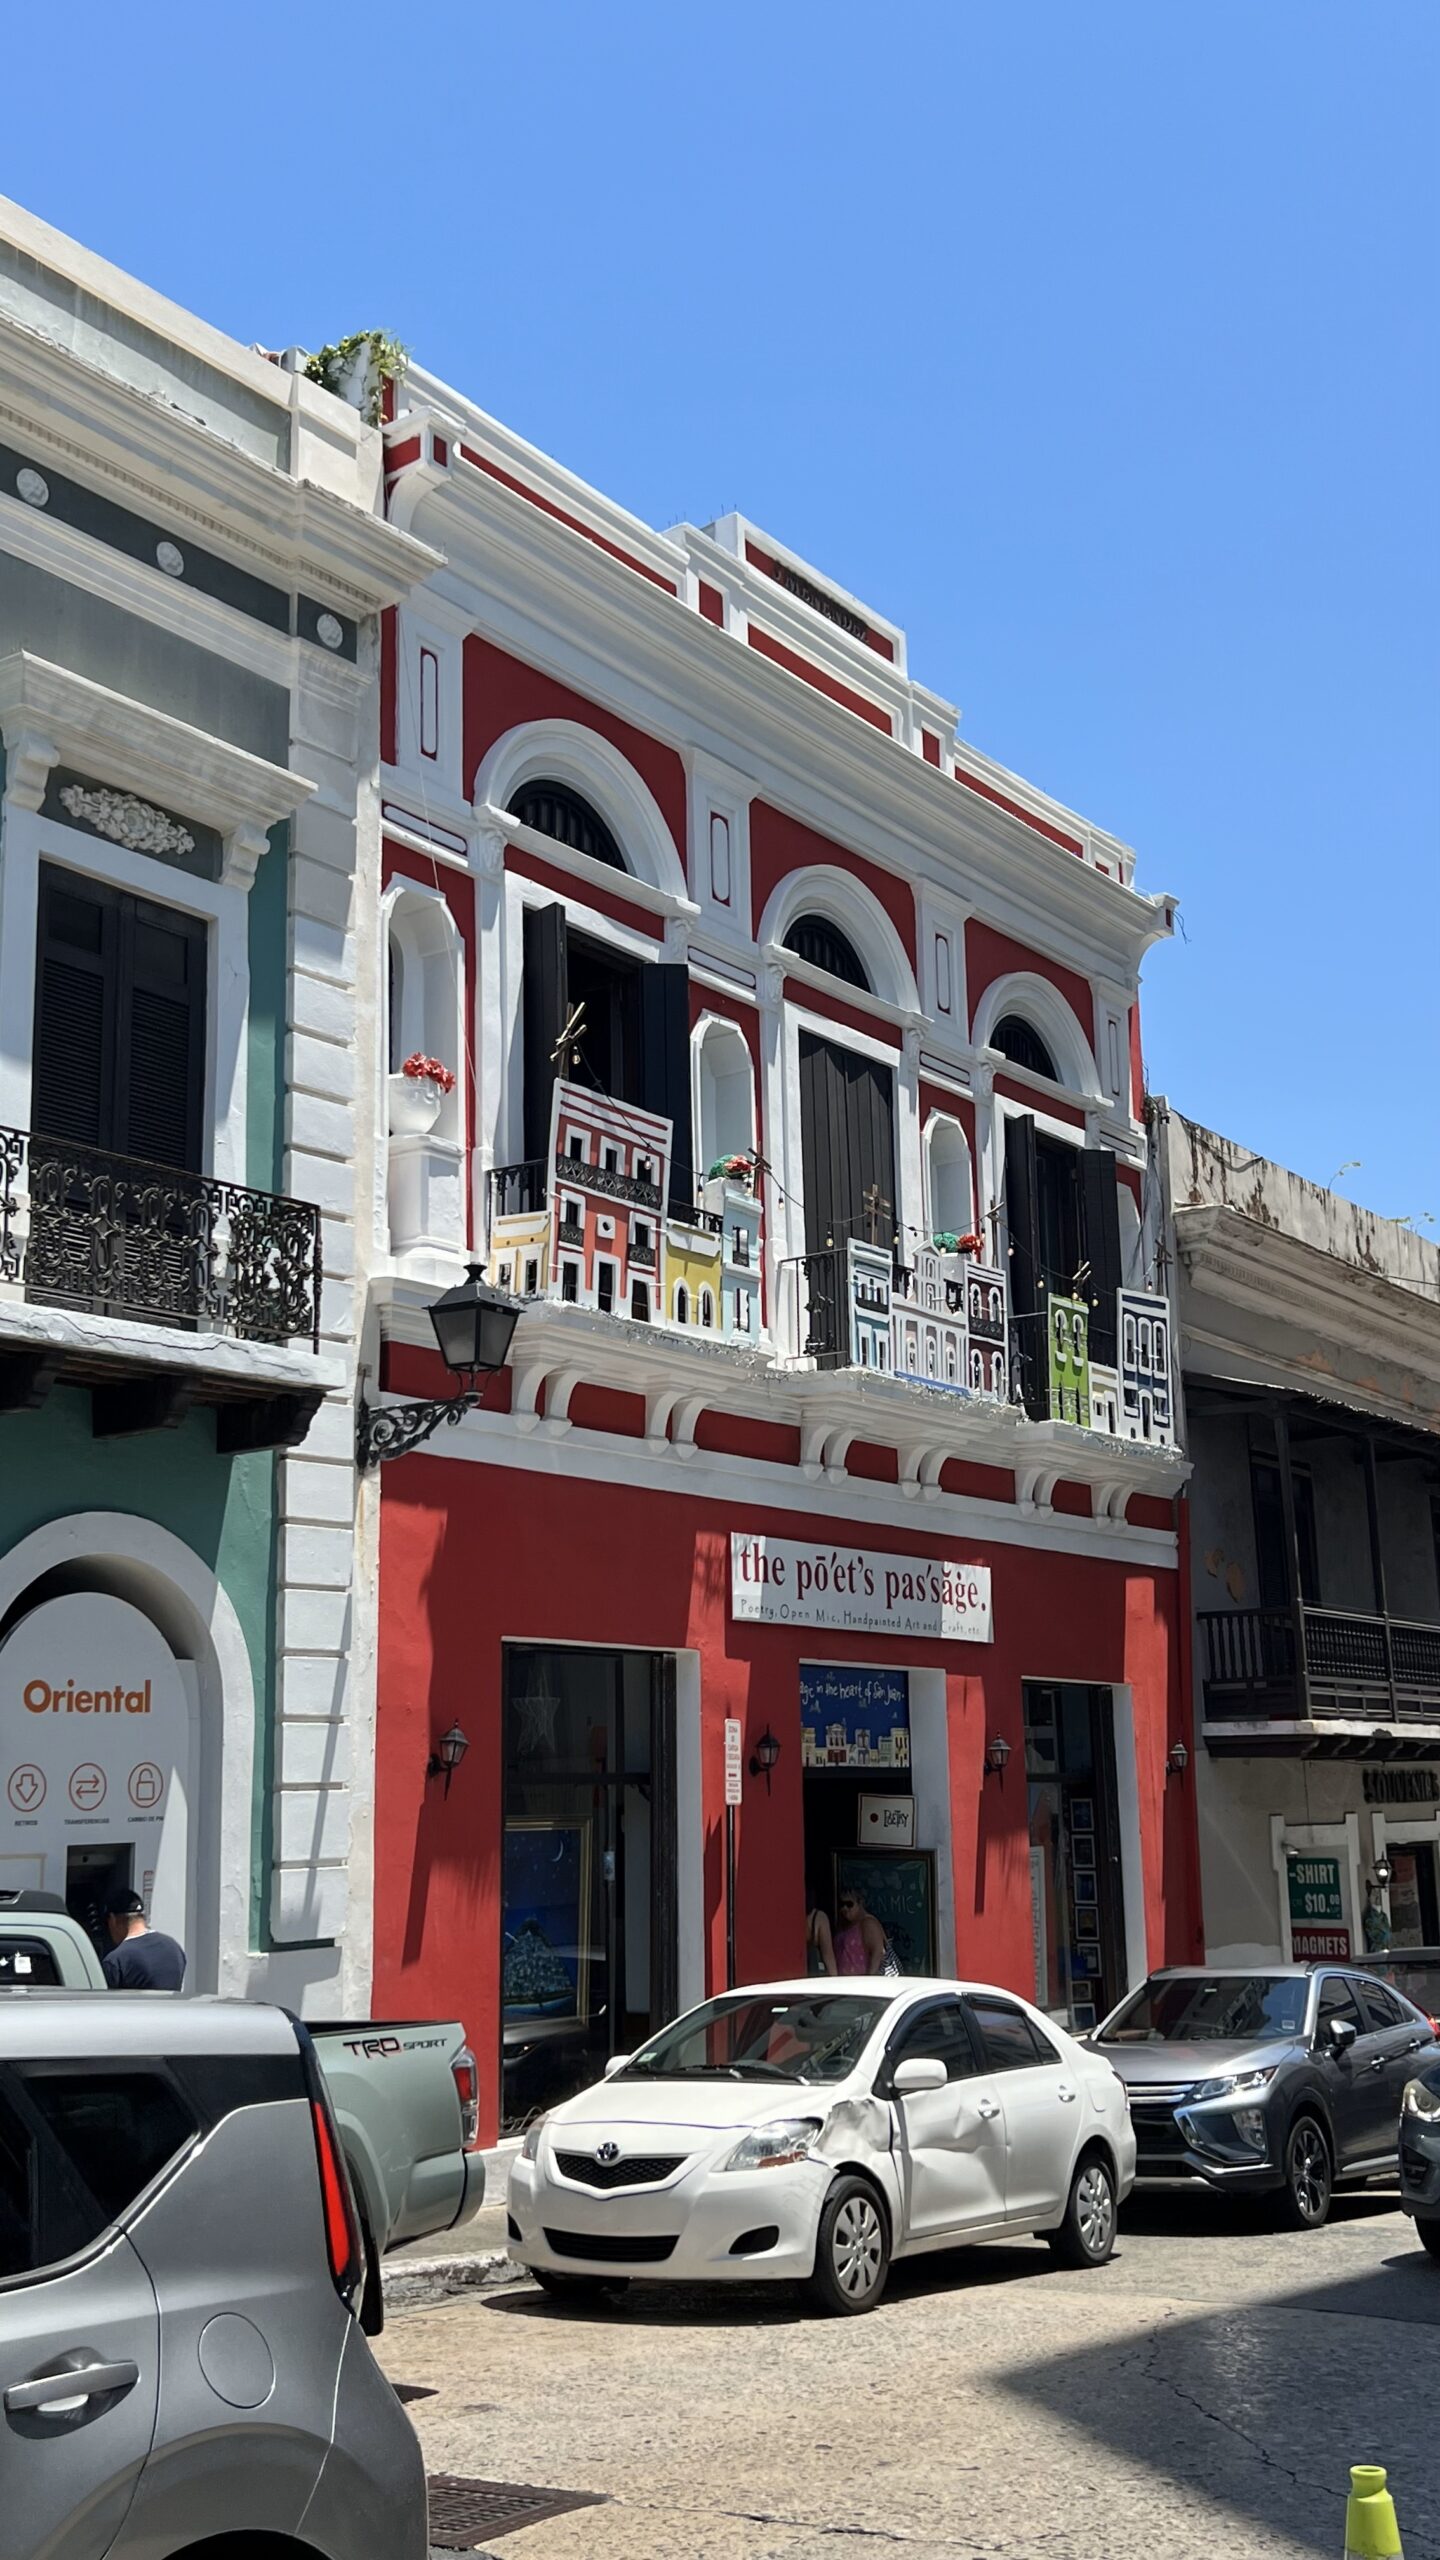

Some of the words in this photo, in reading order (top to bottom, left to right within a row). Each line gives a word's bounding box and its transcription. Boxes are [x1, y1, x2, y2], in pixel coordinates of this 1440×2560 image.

[740, 1543, 786, 1586] the
[741, 1599, 777, 1620] Poetry,
[780, 1604, 810, 1620] Open
[843, 1611, 901, 1630] Handpainted
[905, 1618, 921, 1631] Art
[923, 1621, 938, 1632] and
[23, 1679, 152, 1714] Oriental
[800, 1681, 815, 1705] agic
[816, 1680, 824, 1694] in
[825, 1682, 838, 1696] the
[839, 1680, 863, 1699] heart
[864, 1680, 872, 1704] of
[873, 1681, 886, 1699] San
[1289, 1863, 1335, 1885] -SHIRT
[1293, 1936, 1348, 1955] MAGNETS
[343, 2037, 400, 2059] TRD
[403, 2038, 448, 2050] SPORT
